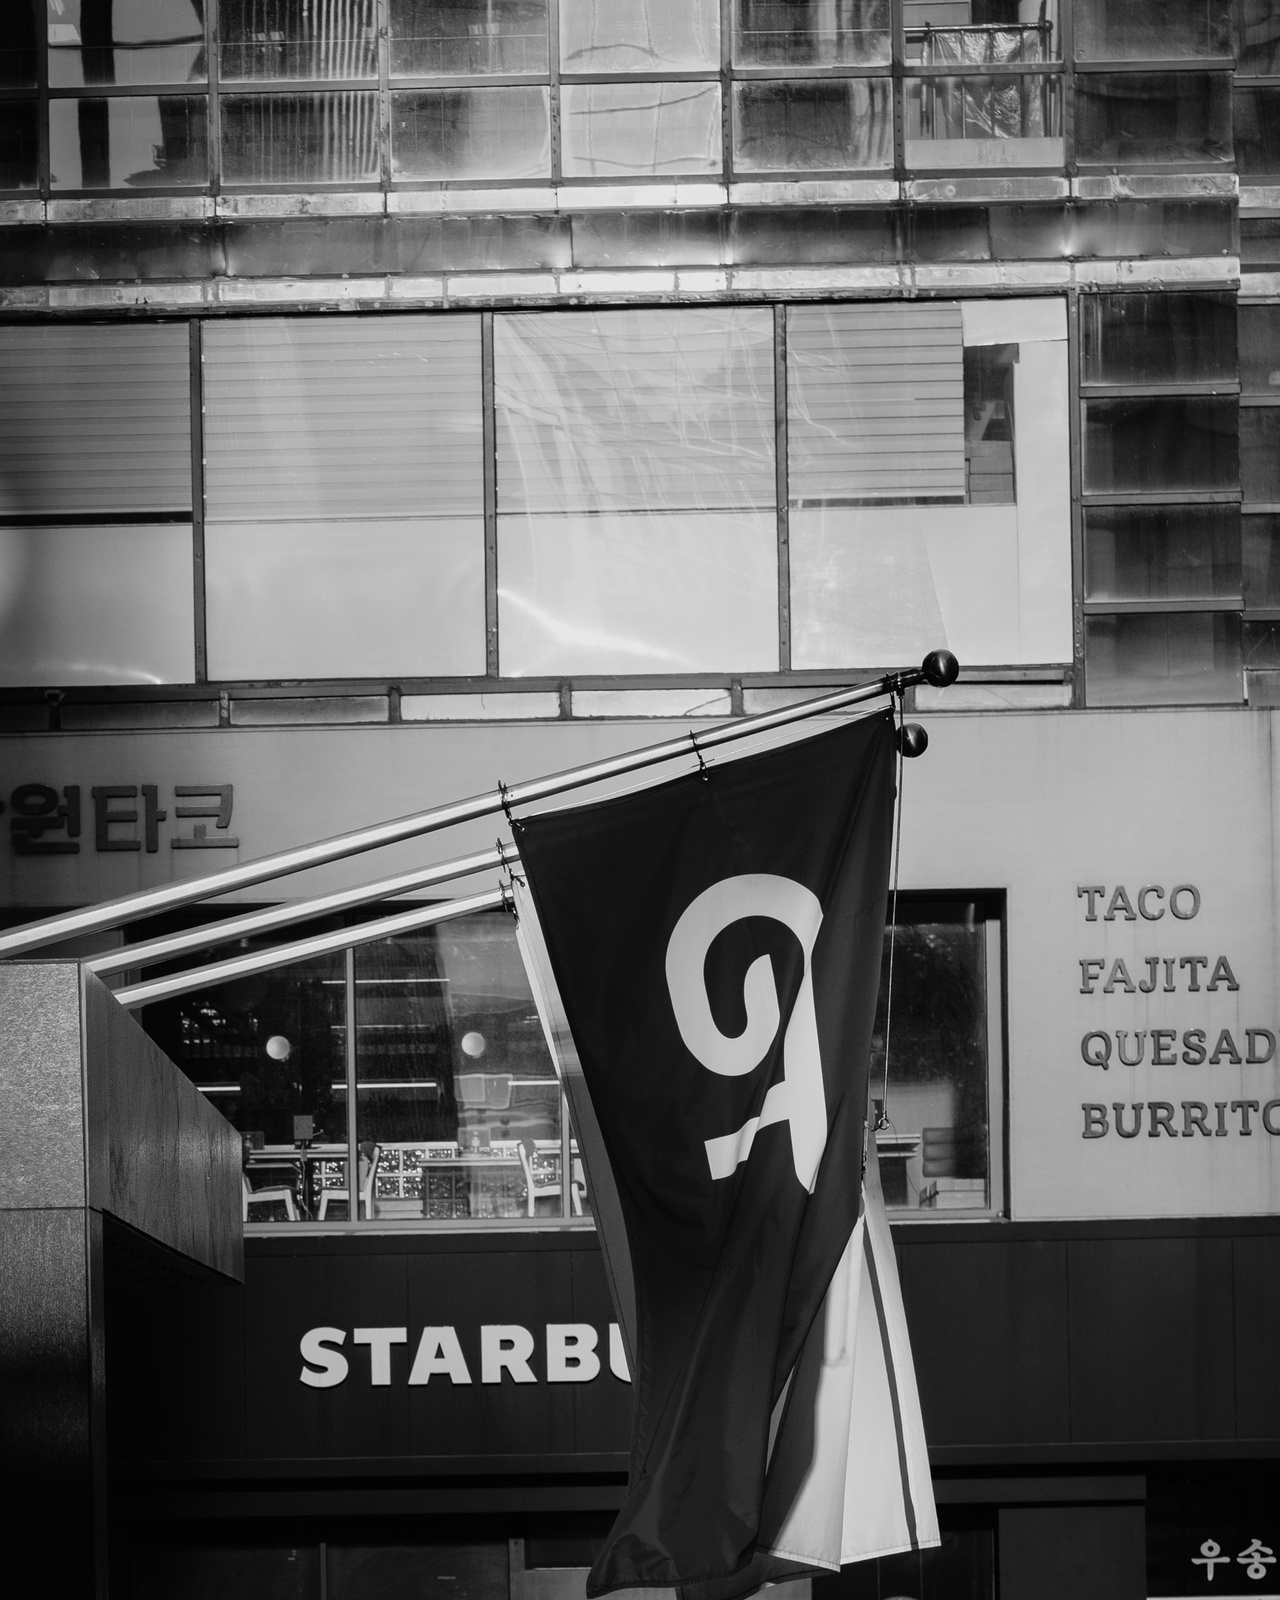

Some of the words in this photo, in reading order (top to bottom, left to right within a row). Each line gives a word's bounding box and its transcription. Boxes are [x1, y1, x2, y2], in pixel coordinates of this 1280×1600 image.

[1077, 884, 1200, 921] TACO
[1079, 955, 1239, 993] FAJITA
[1081, 1028, 1280, 1070] QUESAD
[1191, 1538, 1277, 1581] 우송
